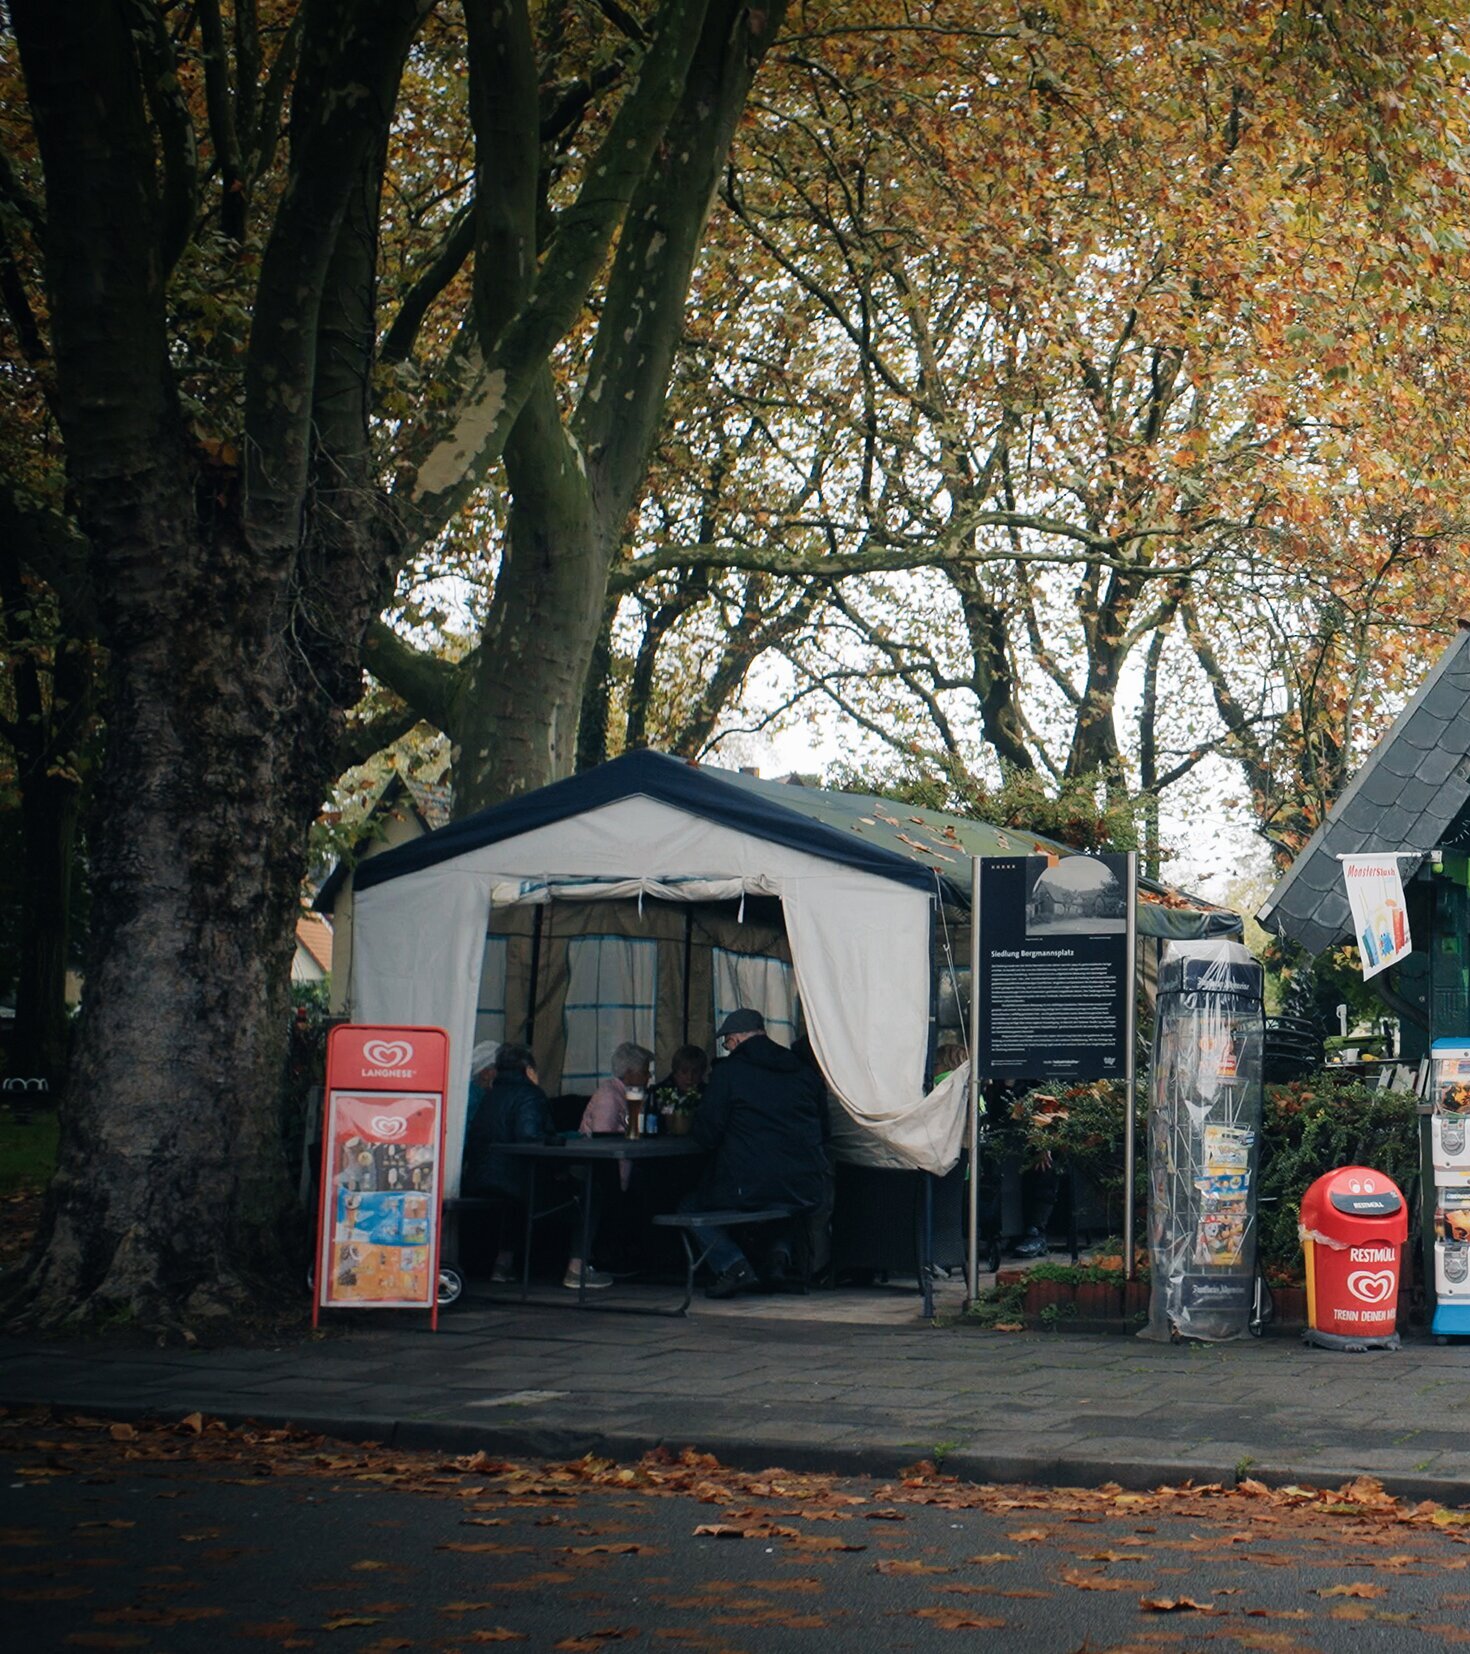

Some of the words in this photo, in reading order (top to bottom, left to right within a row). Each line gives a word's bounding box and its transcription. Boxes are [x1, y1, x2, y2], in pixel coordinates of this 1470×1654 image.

[991, 950, 1020, 959] Siedlung
[1021, 949, 1075, 958] Bergmannsplatz
[361, 1068, 412, 1078] LANGNESE
[1350, 1246, 1396, 1262] RESTMÜLL
[1334, 1308, 1359, 1322] TRENN
[1361, 1308, 1387, 1322] DEINEN
